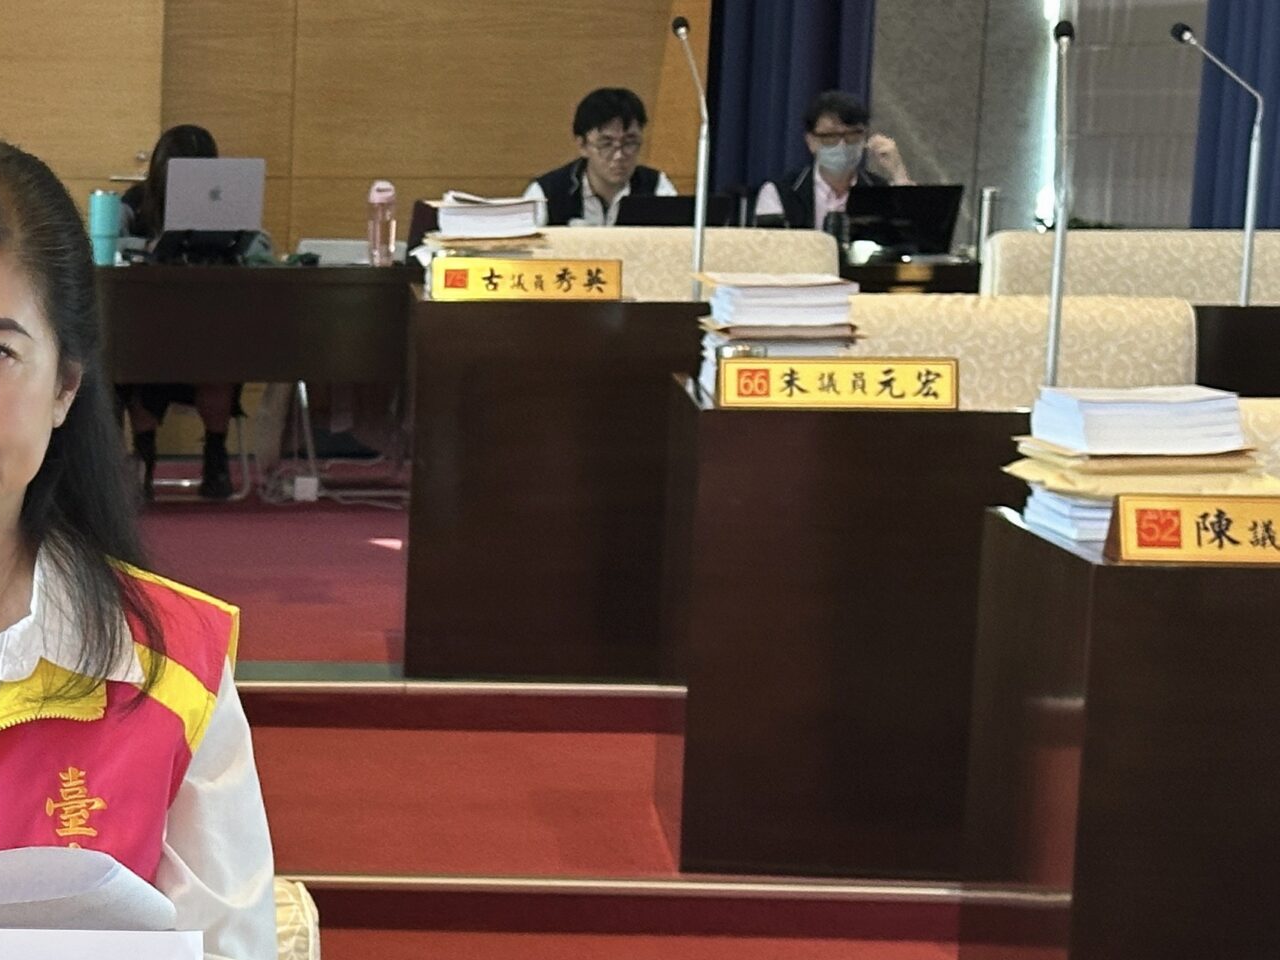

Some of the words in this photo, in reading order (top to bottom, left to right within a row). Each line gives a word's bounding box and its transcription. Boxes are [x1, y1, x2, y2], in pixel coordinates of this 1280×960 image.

[482, 267, 607, 293] 古議員秀英
[739, 370, 769, 396] 66
[1139, 512, 1181, 543] 52
[45, 766, 108, 848] 臺
